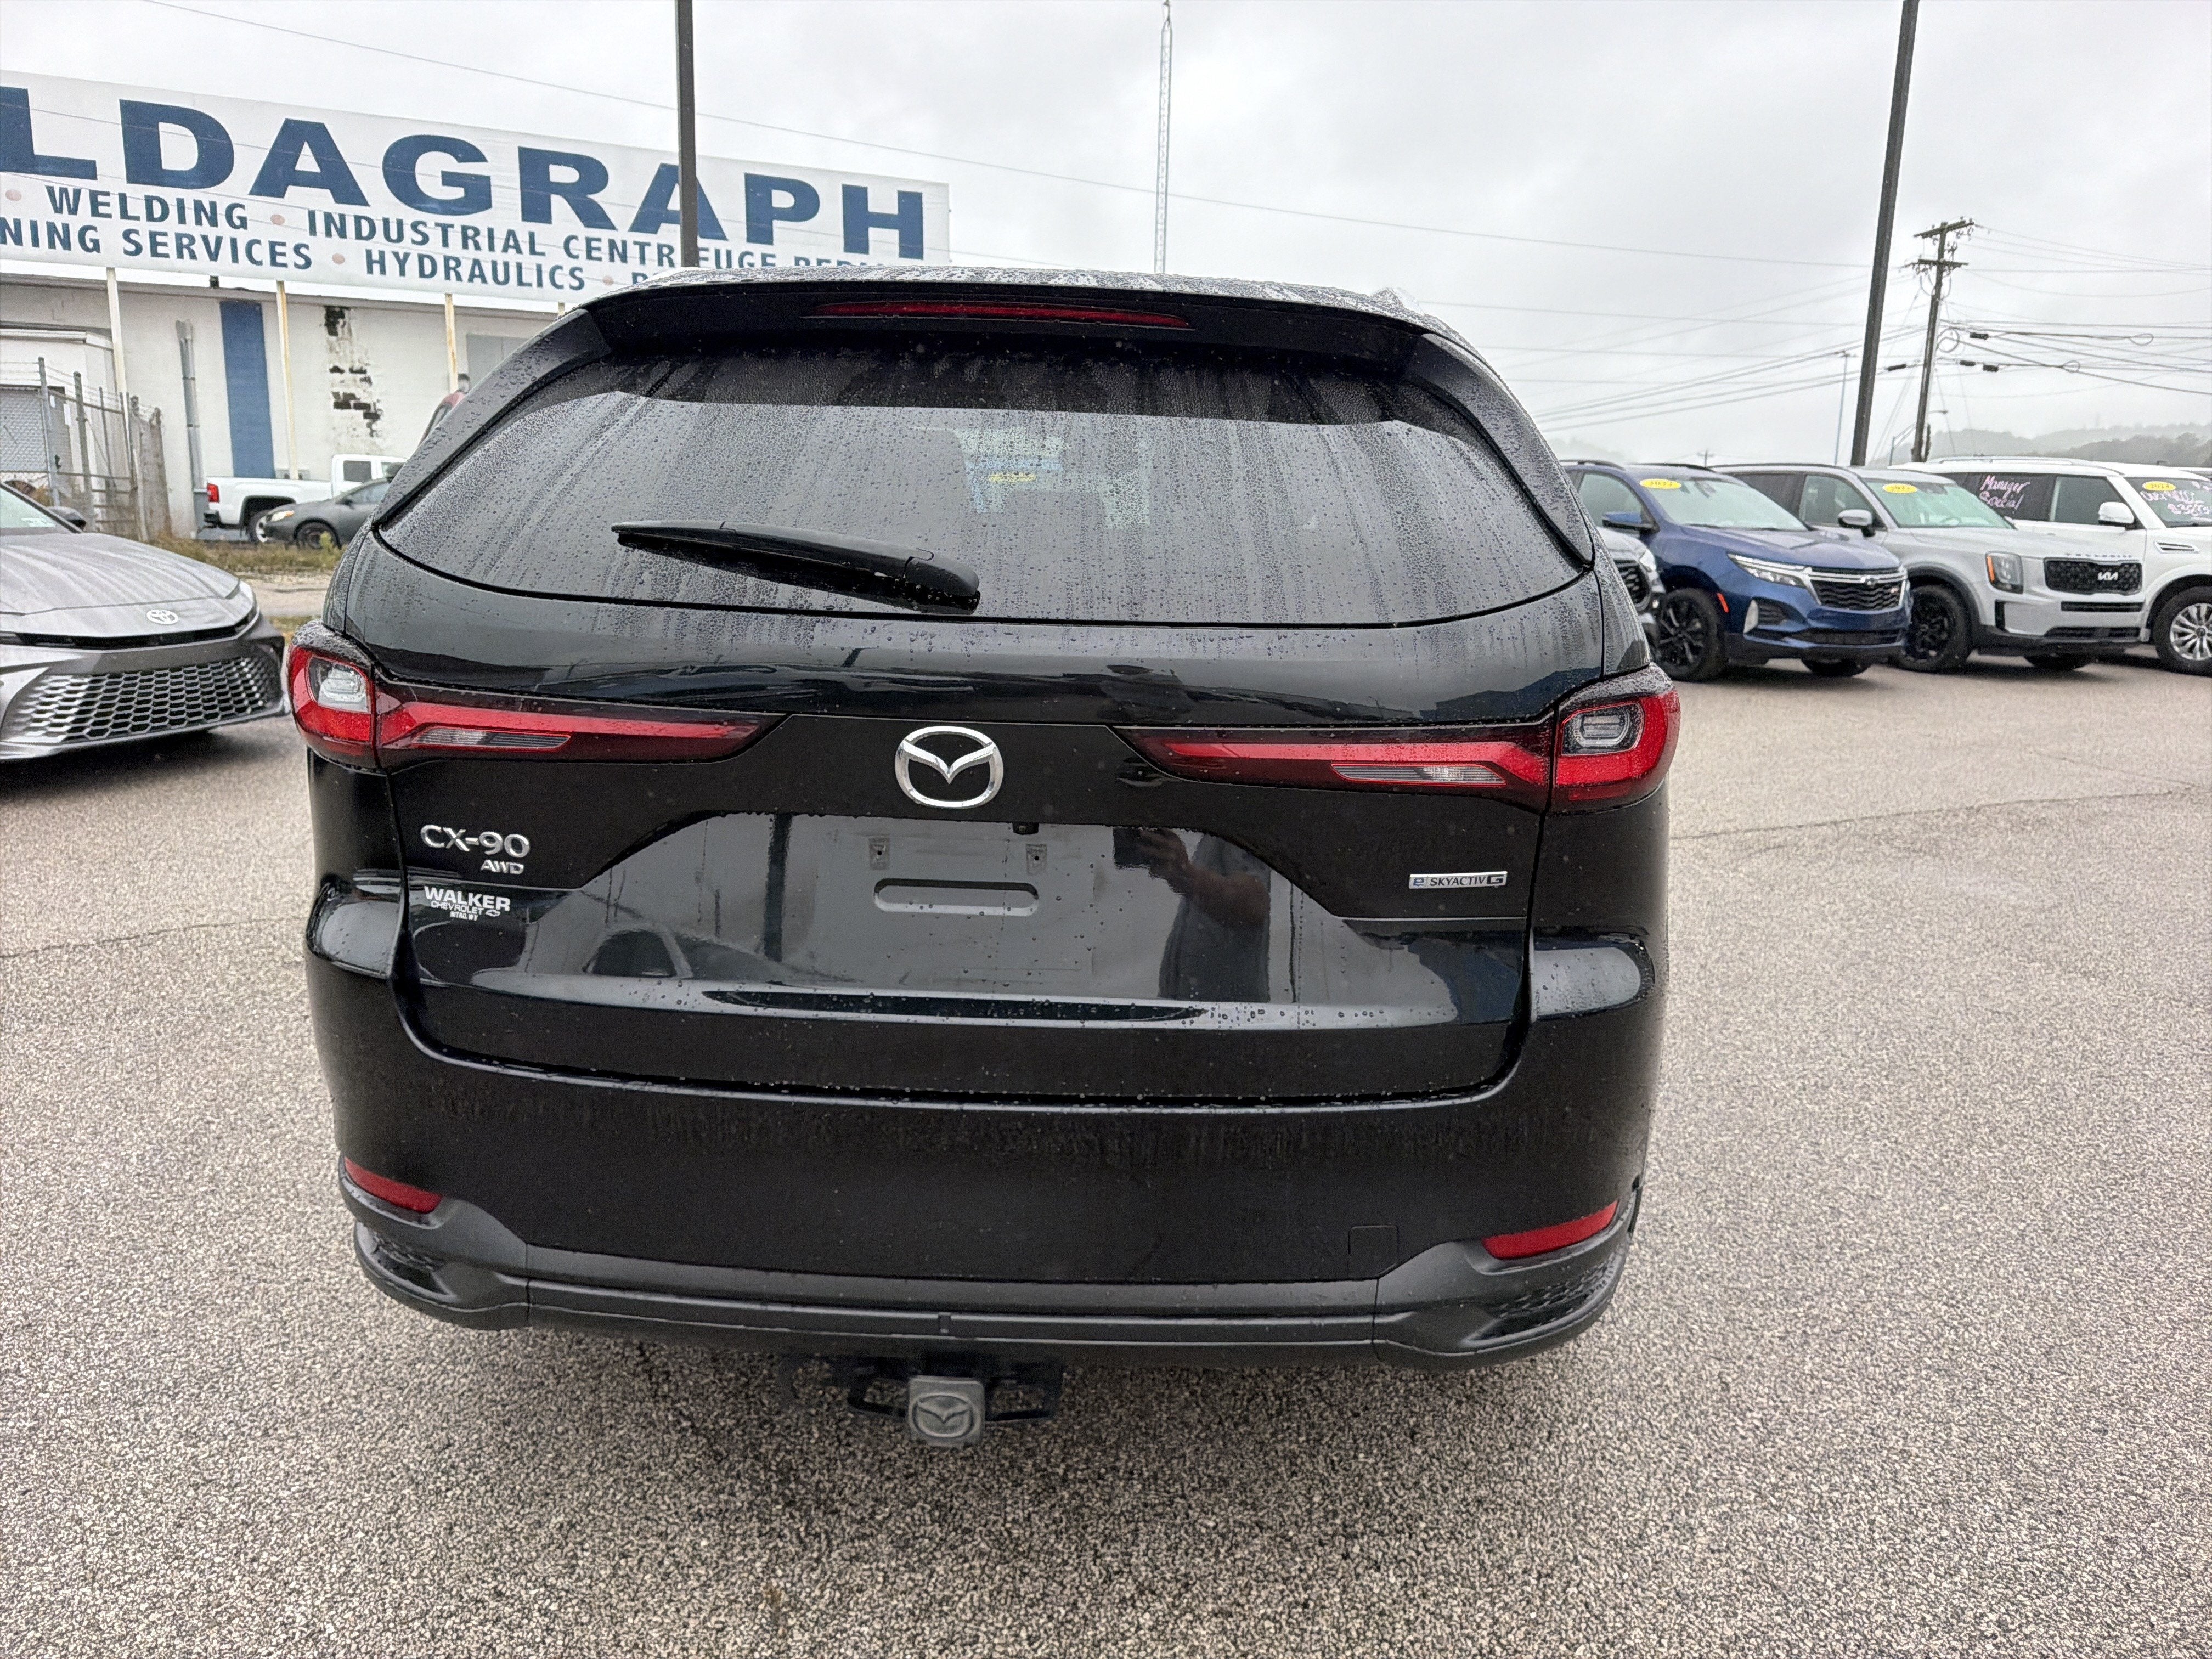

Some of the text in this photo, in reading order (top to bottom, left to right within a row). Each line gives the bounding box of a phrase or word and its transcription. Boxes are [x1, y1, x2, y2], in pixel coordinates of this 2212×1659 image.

[45, 185, 776, 269] WELDING INDUSTRIAL CENTRUGE
[0, 217, 585, 291] NING SERVICES HYDRAULICS
[420, 825, 531, 858] CX-90
[480, 859, 524, 874] AWD
[1429, 876, 1486, 887] SKYACTIV
[424, 885, 511, 912] WALKER
[431, 900, 484, 915] CHEVROLET
